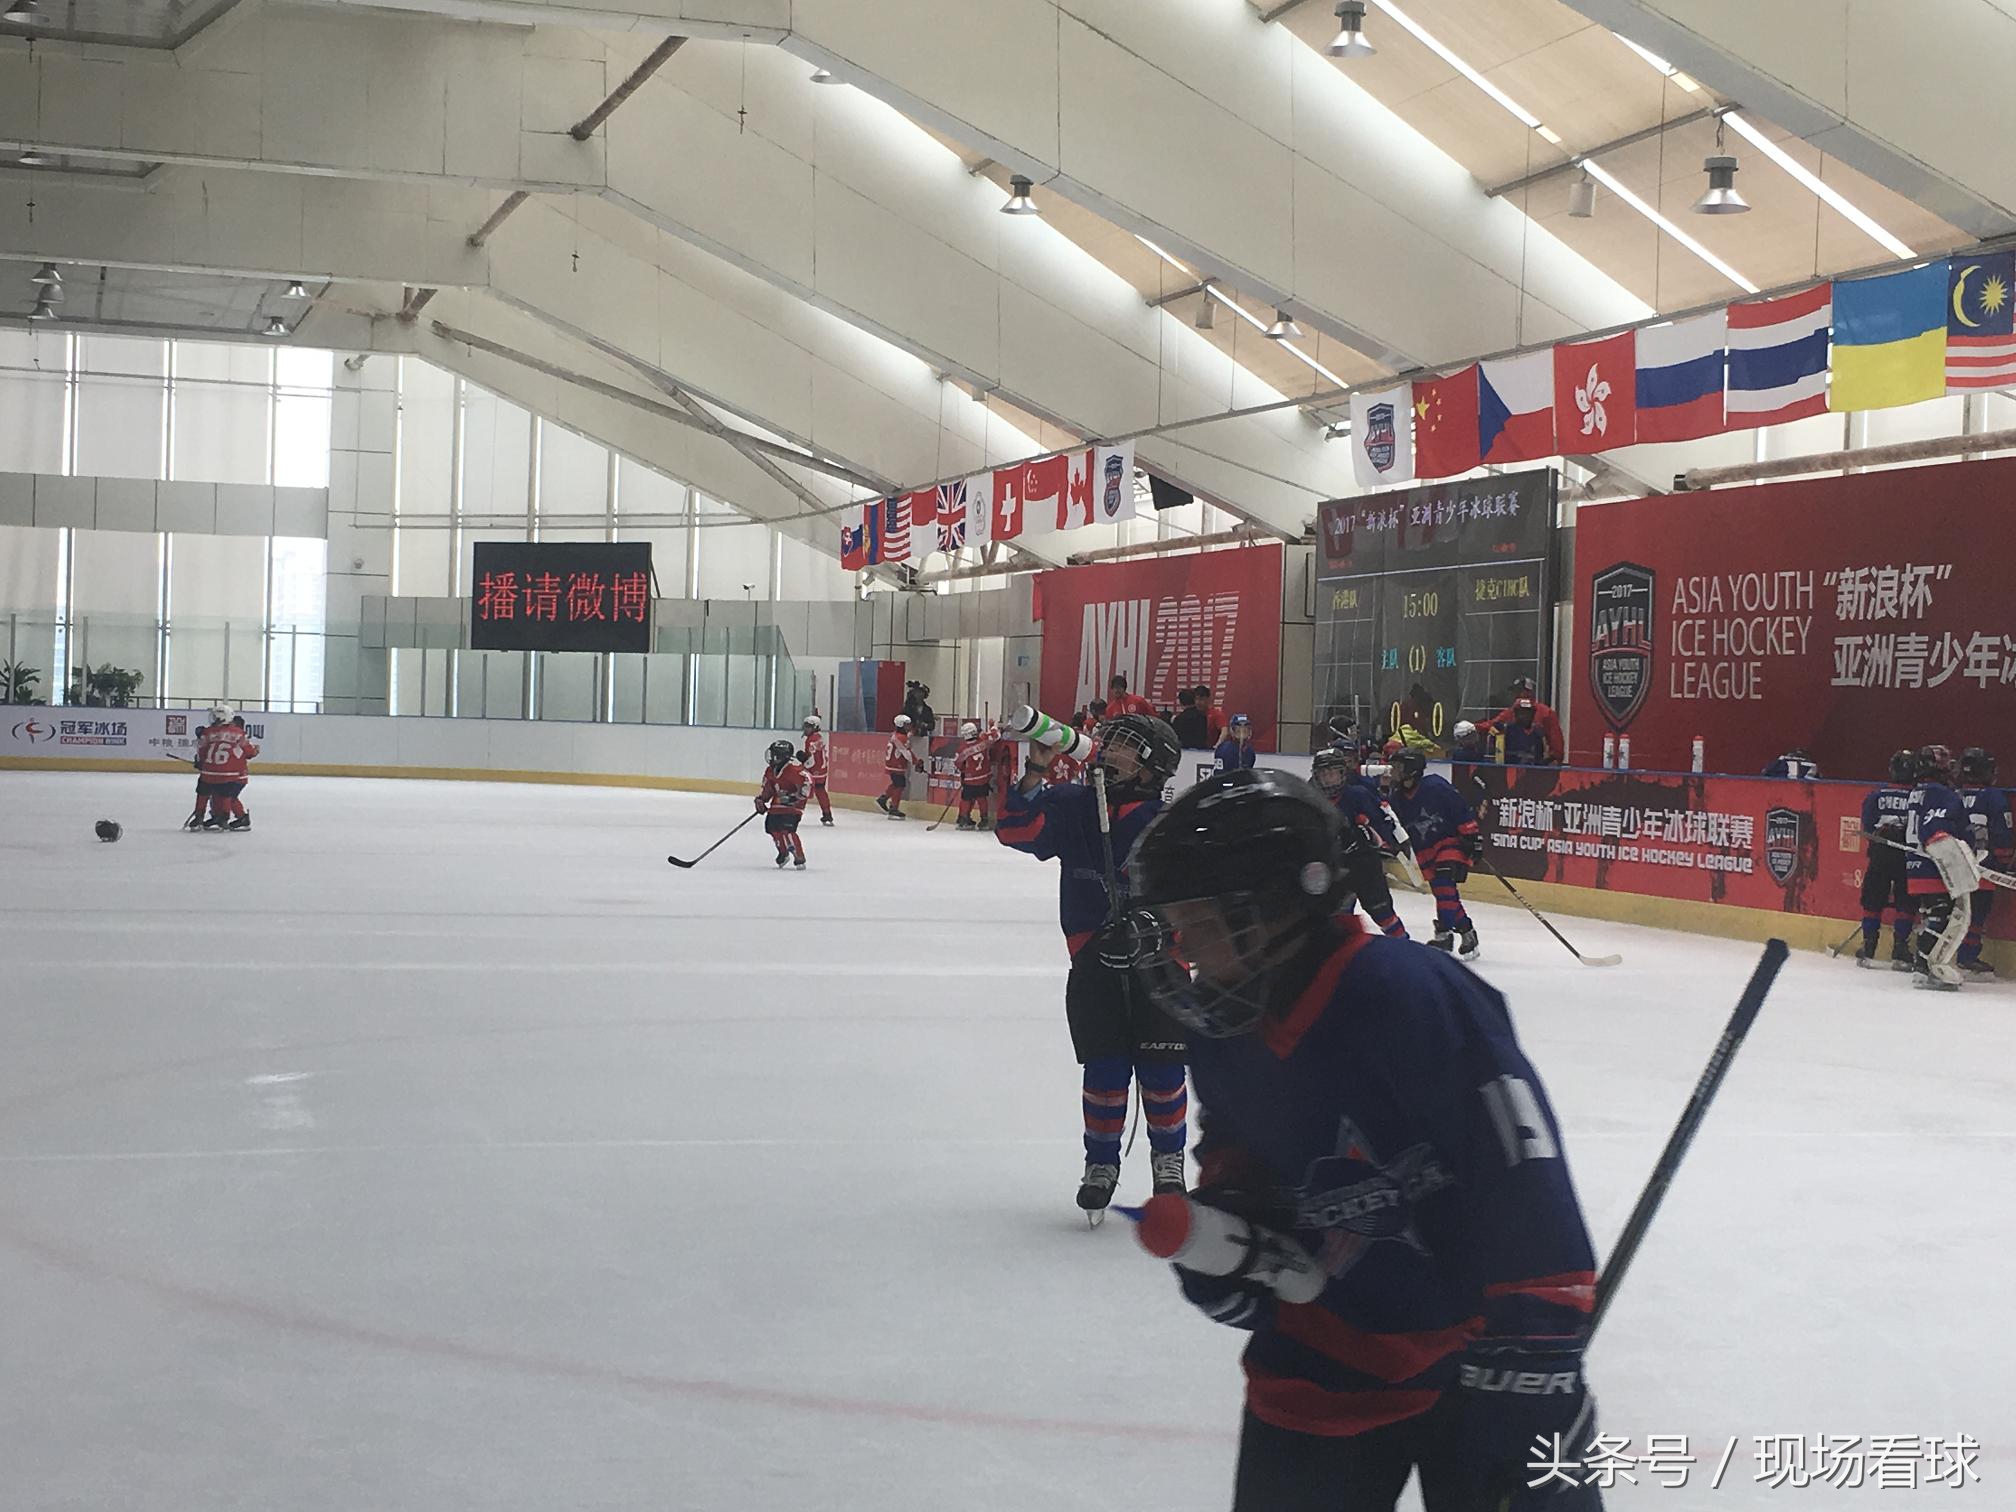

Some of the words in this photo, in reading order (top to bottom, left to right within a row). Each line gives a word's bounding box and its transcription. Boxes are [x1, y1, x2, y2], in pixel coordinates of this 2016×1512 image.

[478, 571, 647, 623] 播请微博
[1404, 592, 1439, 619] 15:00
[1611, 584, 1633, 598] 2017
[1671, 575, 1724, 614] ASIA
[1728, 570, 1814, 612] YOUTH
[1593, 606, 1646, 648] AYHL
[1671, 619, 1706, 657] ICE
[1713, 616, 1812, 656] HOCKEY
[1670, 661, 1762, 699] LEAGUE
[61, 721, 127, 736] 冠军冰场
[205, 742, 232, 765] 16
[1547, 838, 1574, 855] ASIA
[1575, 841, 1616, 859] YOUTH
